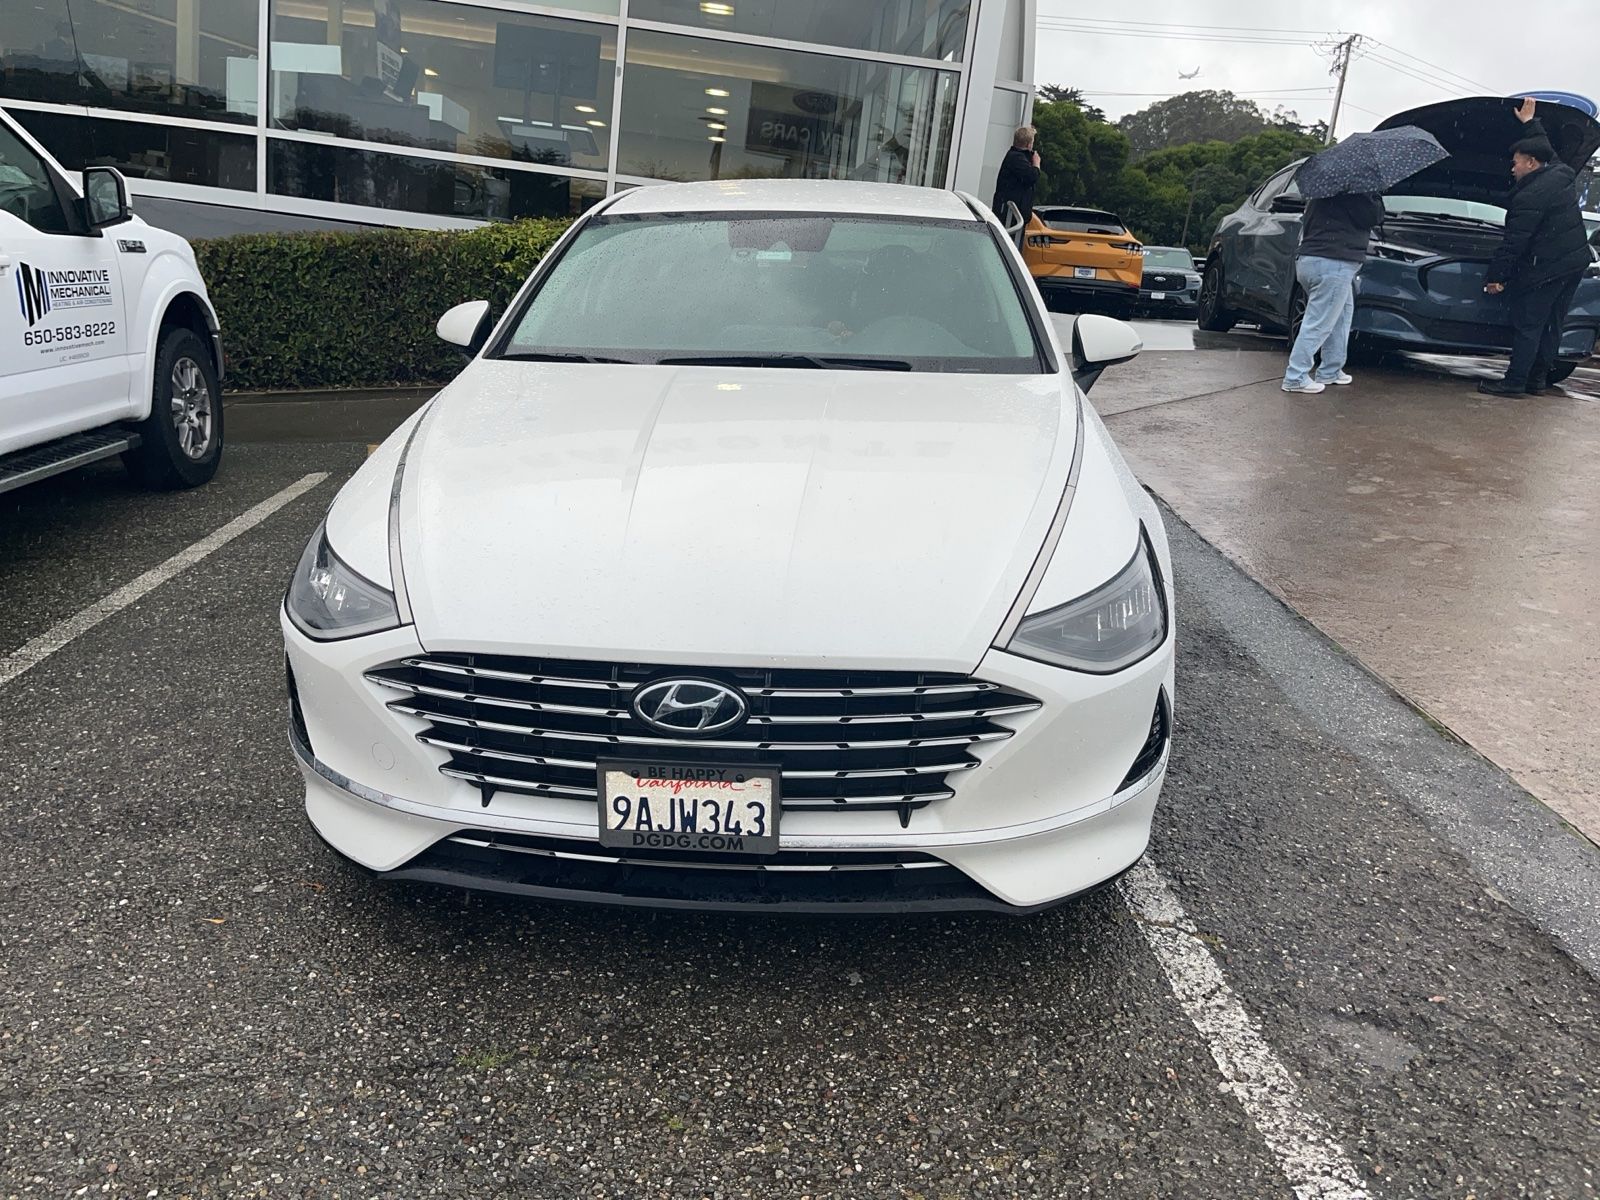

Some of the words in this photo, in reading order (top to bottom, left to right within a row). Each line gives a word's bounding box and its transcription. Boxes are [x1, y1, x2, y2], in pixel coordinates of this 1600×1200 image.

[47, 269, 110, 284] INNOVATIVE
[50, 285, 111, 299] MECHANICAL
[24, 321, 116, 346] 650-583-8222
[648, 766, 670, 779] BE
[672, 767, 728, 781] HAPPY
[612, 795, 766, 837] 9AJW343
[632, 833, 744, 851] DGDG.COM
